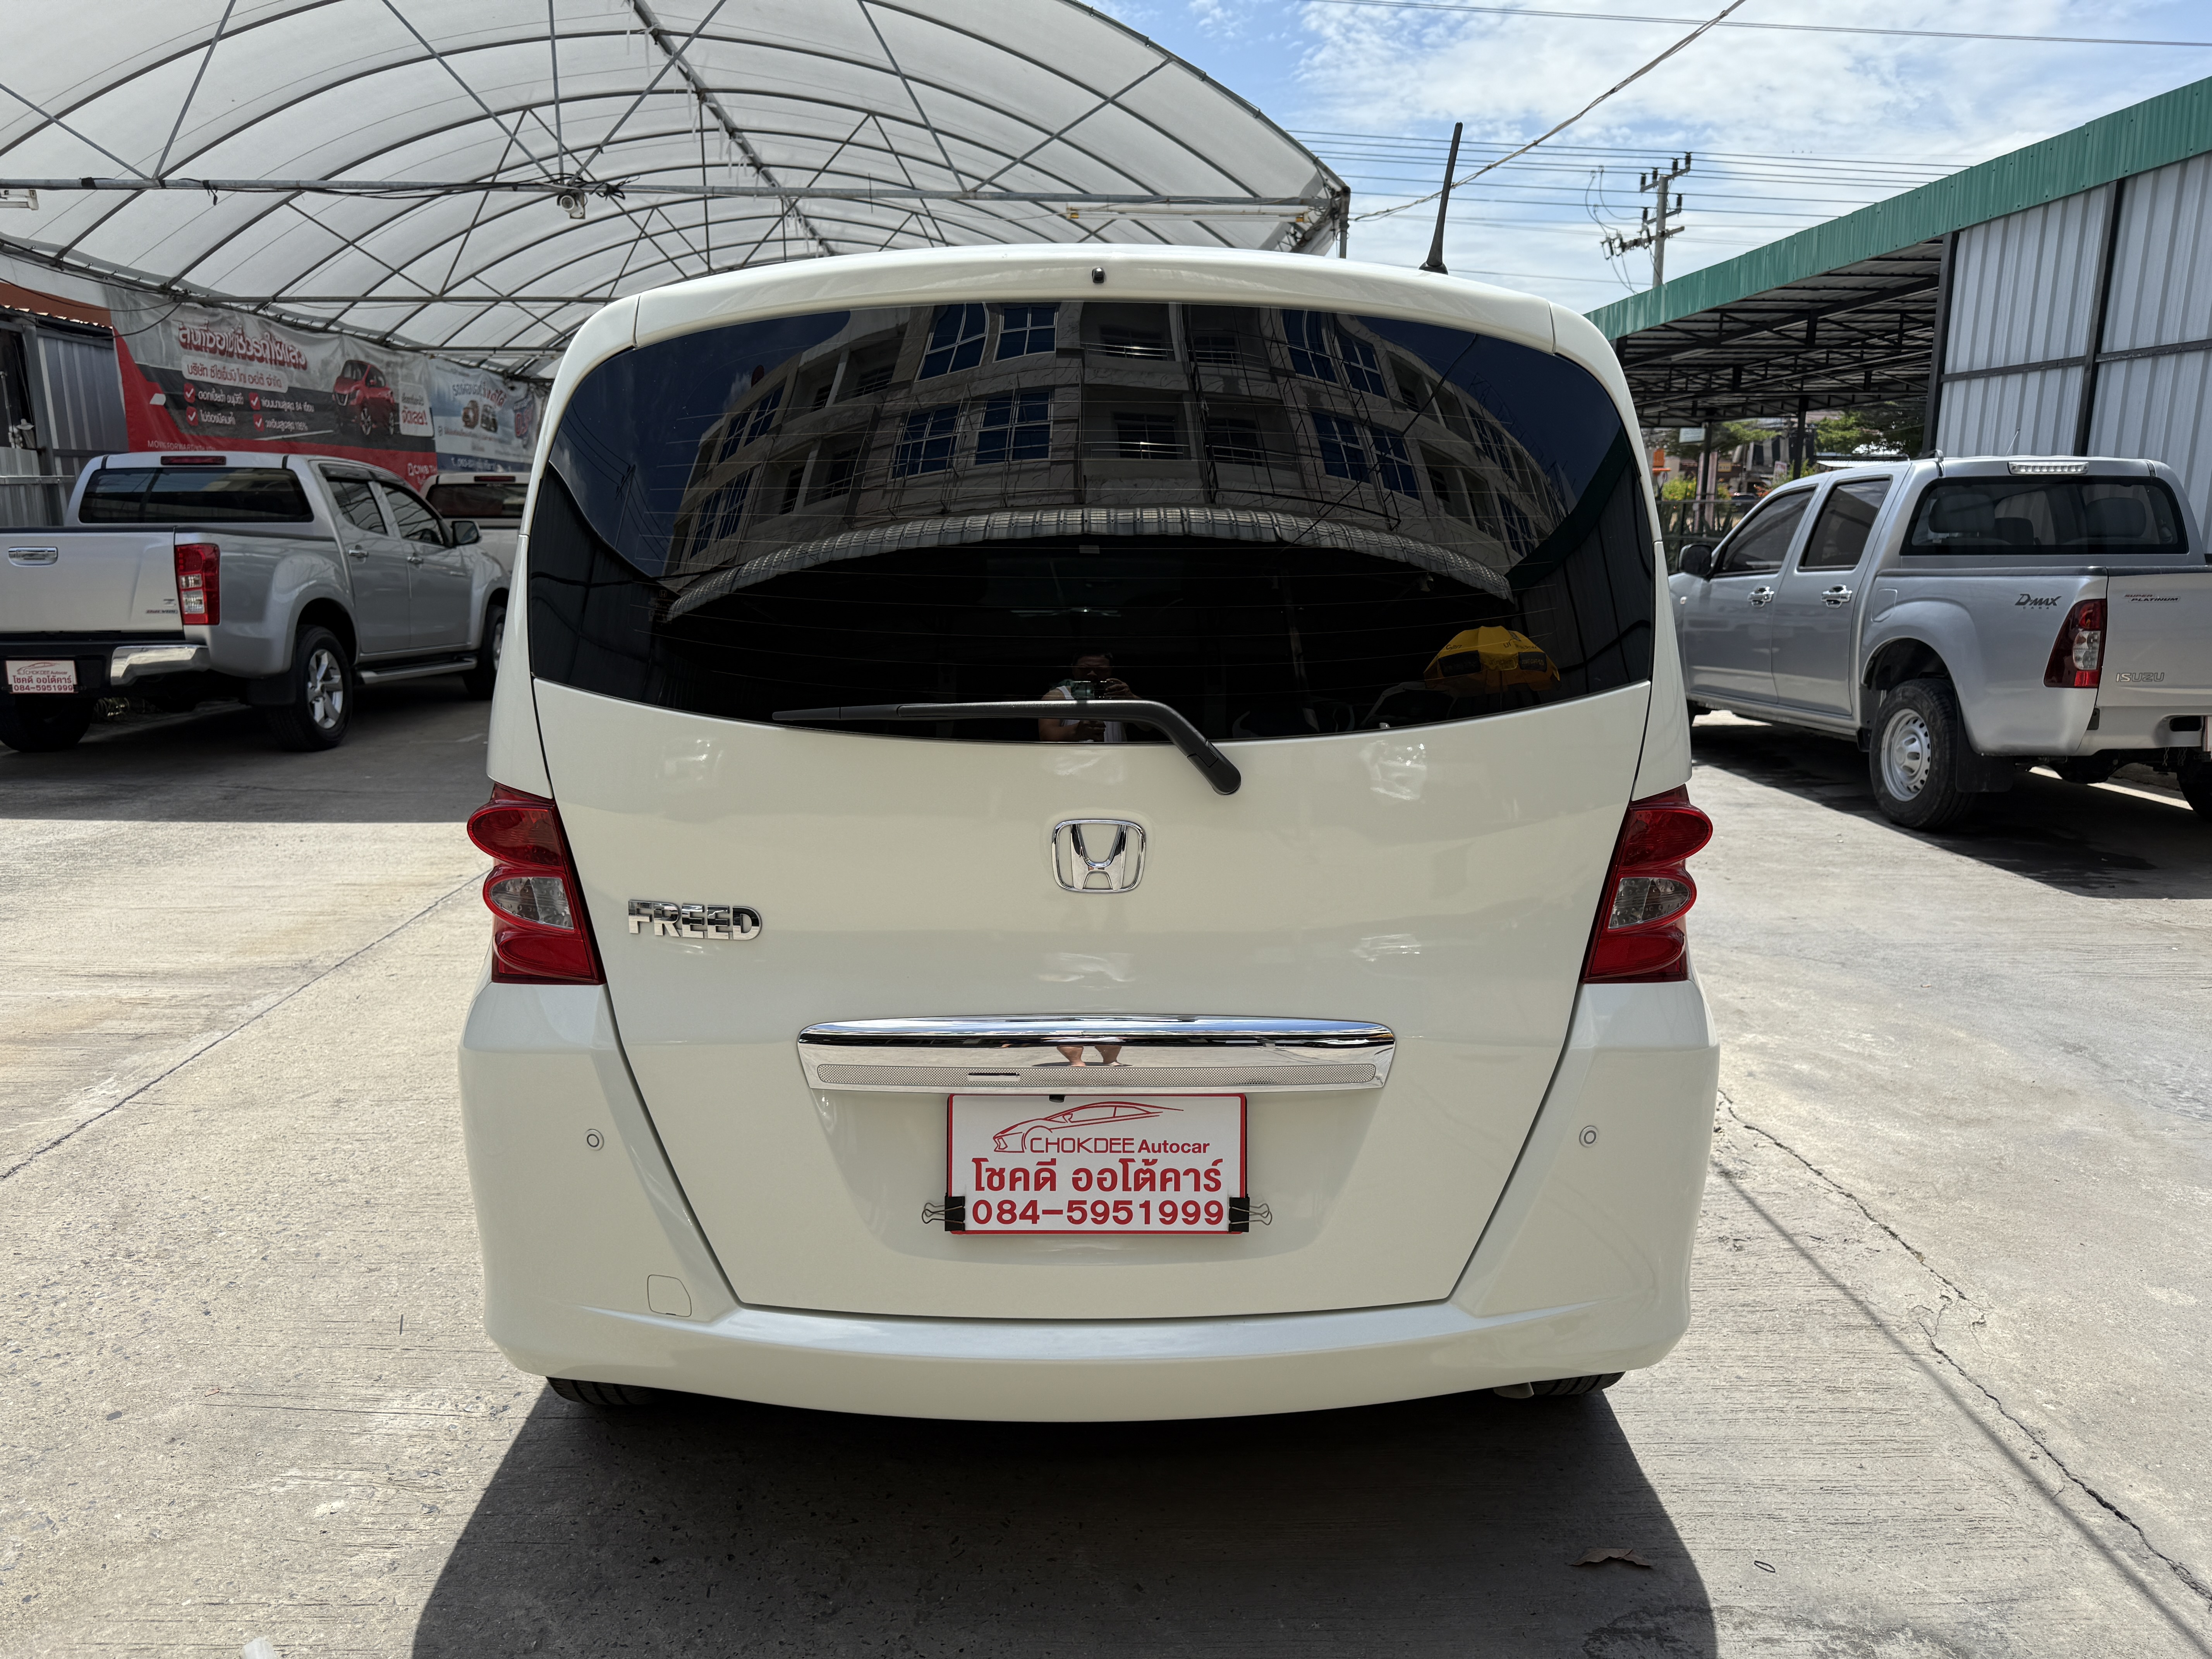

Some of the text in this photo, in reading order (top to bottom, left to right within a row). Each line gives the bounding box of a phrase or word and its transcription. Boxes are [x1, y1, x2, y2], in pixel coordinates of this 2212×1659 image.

[187, 363, 208, 377] บริษัท
[12, 675, 72, 684] โชคดี ออโต้คาร์
[2116, 673, 2165, 682] ISUZU
[628, 899, 763, 940] FREED
[1029, 1137, 1210, 1154] CHOKDEE Autocar
[971, 1158, 1224, 1192] โชคดี ออโต้คาร์
[972, 1199, 1224, 1226] 084-5951999
